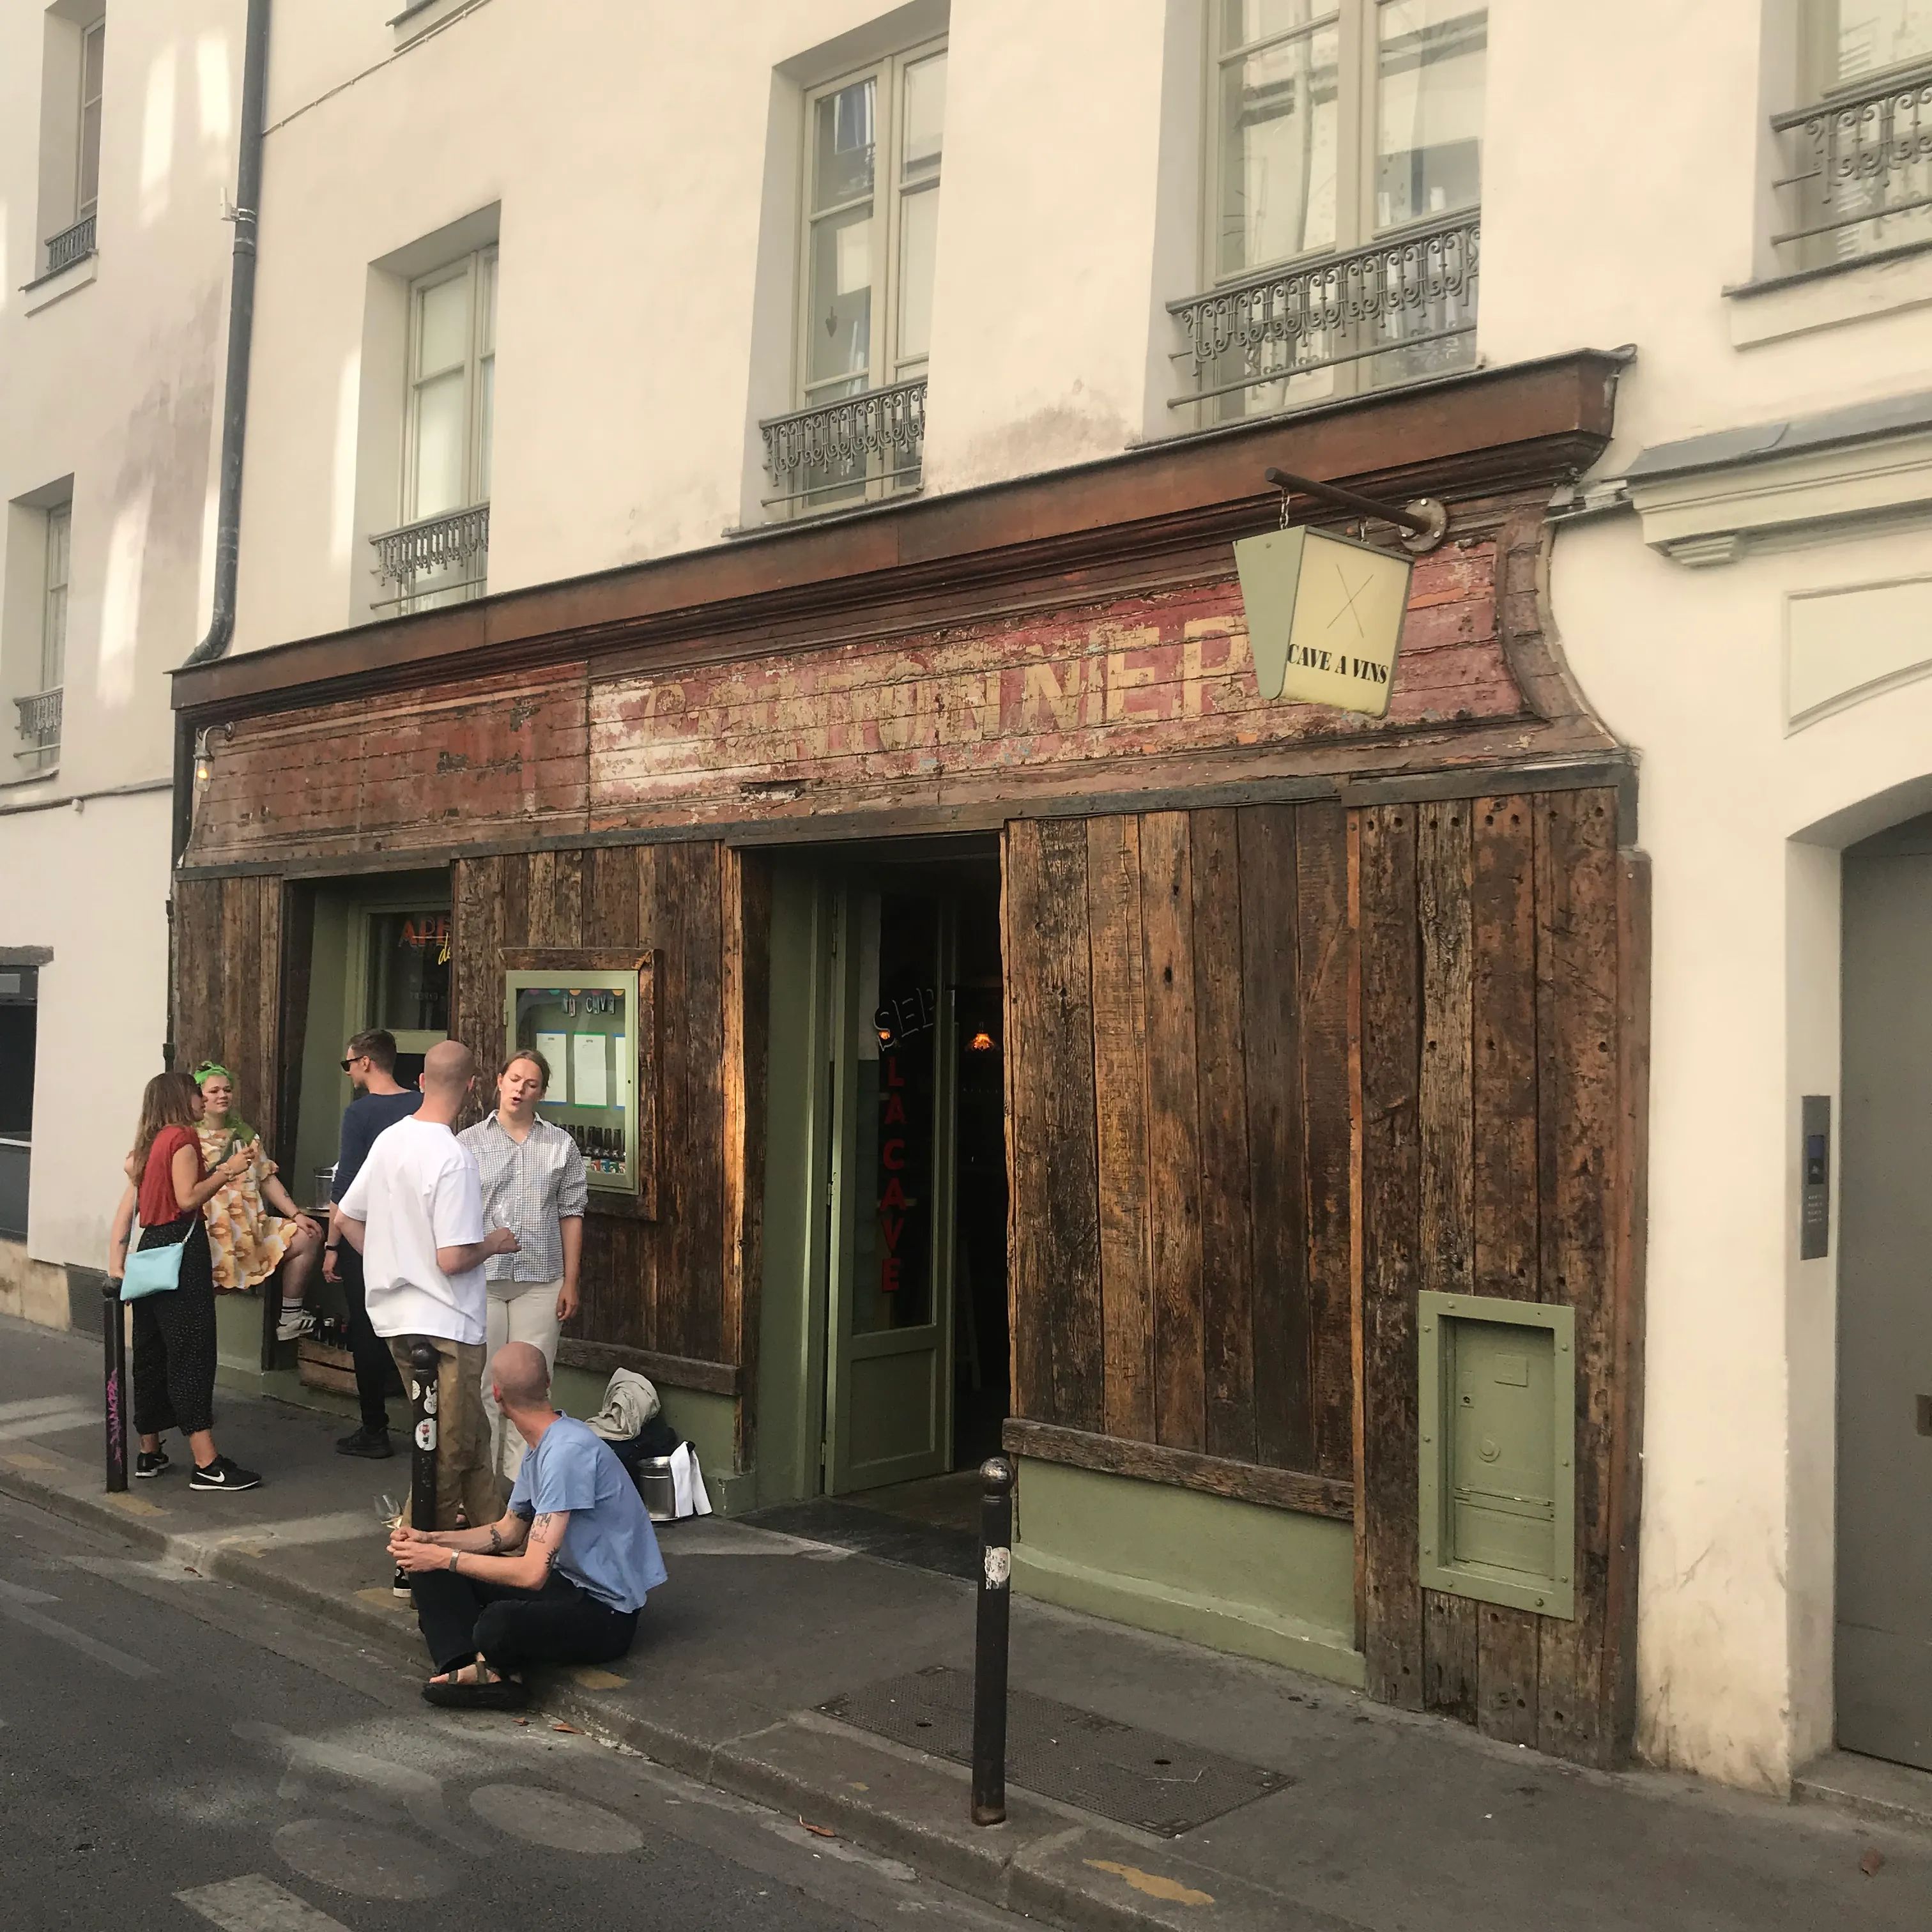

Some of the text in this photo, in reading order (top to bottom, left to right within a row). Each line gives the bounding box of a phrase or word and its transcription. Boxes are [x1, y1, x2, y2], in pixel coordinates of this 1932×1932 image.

[1287, 643, 1388, 684] CAVE A VINS
[880, 1056, 907, 1292] LA CAVE
